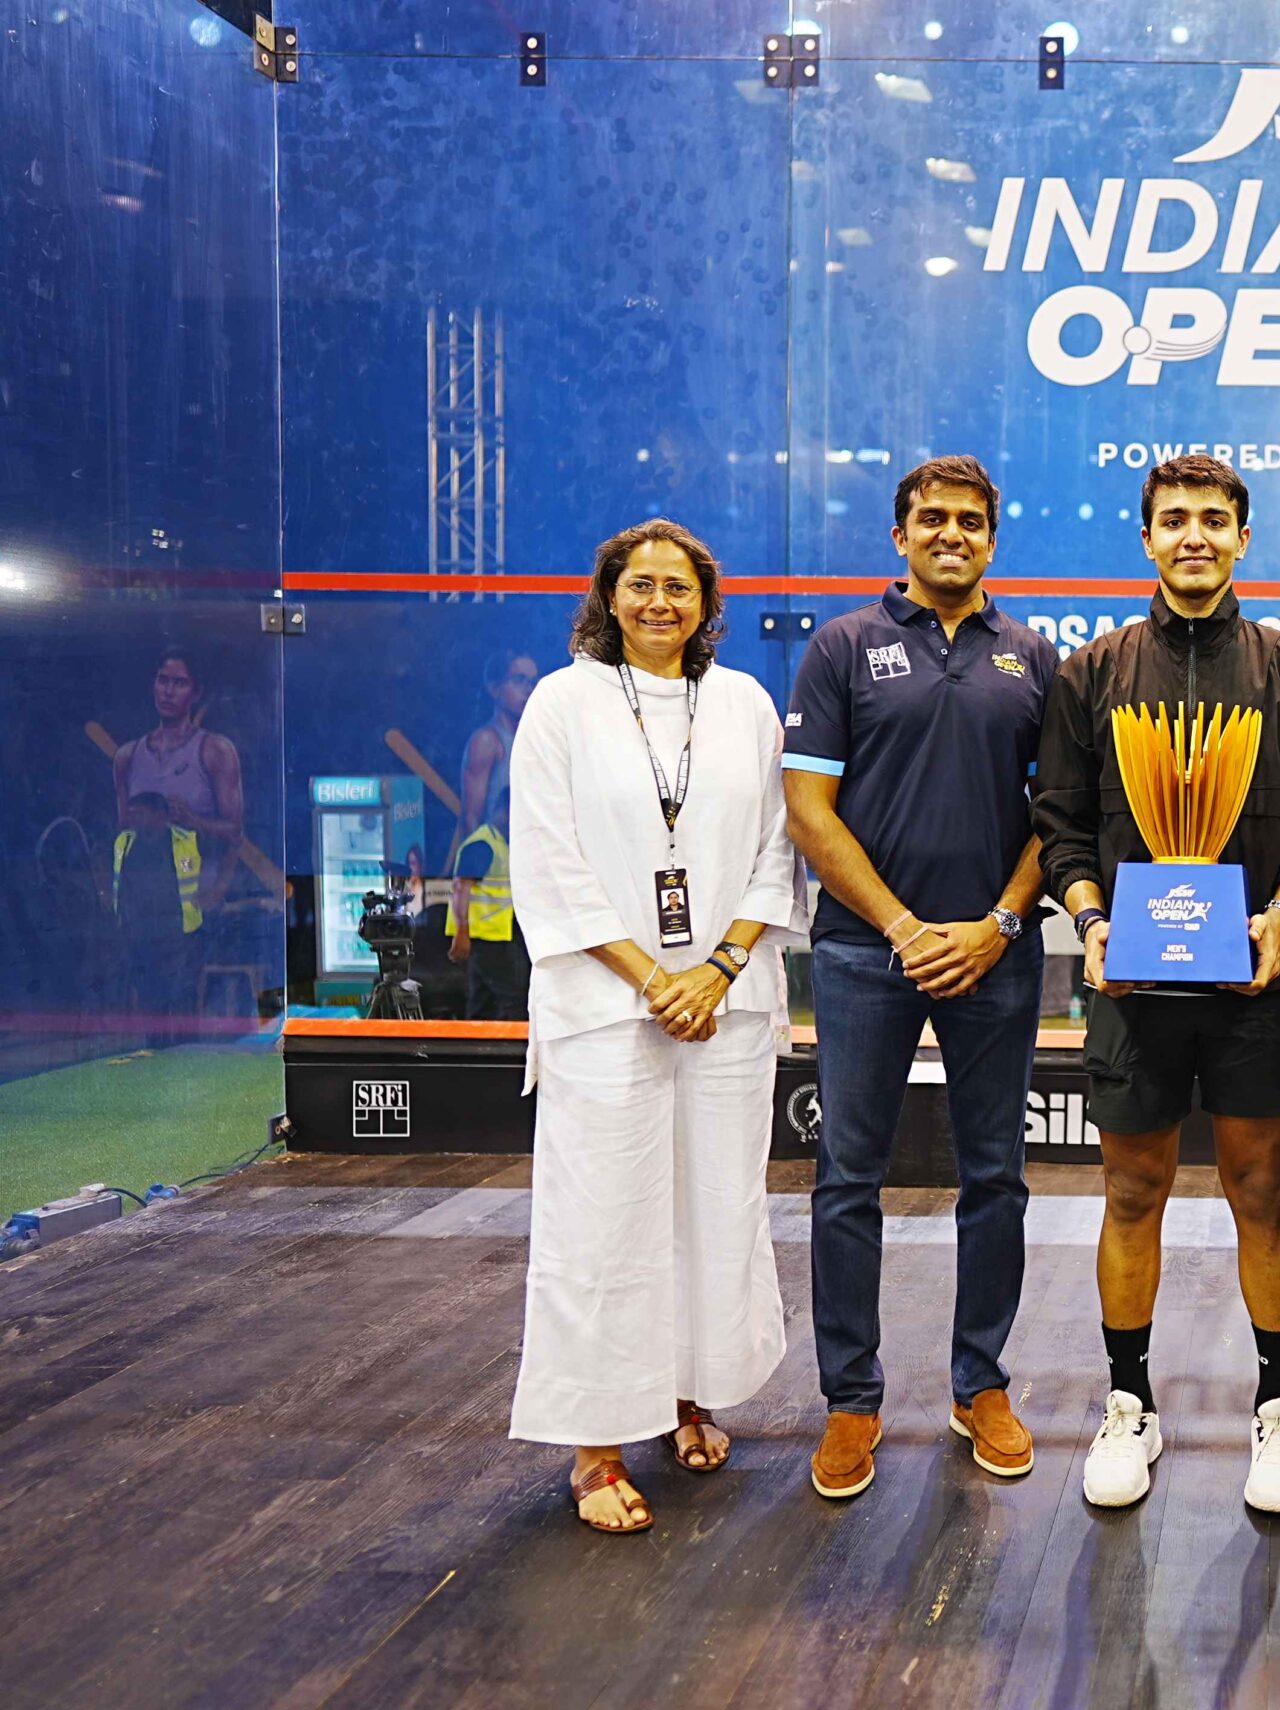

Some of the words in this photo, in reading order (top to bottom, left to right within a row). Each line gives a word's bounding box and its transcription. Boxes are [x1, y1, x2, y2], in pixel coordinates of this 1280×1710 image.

[318, 780, 374, 802] Bisleri
[1147, 899, 1193, 909] INDIAN
[1151, 909, 1189, 920] OPEN
[358, 1084, 404, 1107] SRFi
